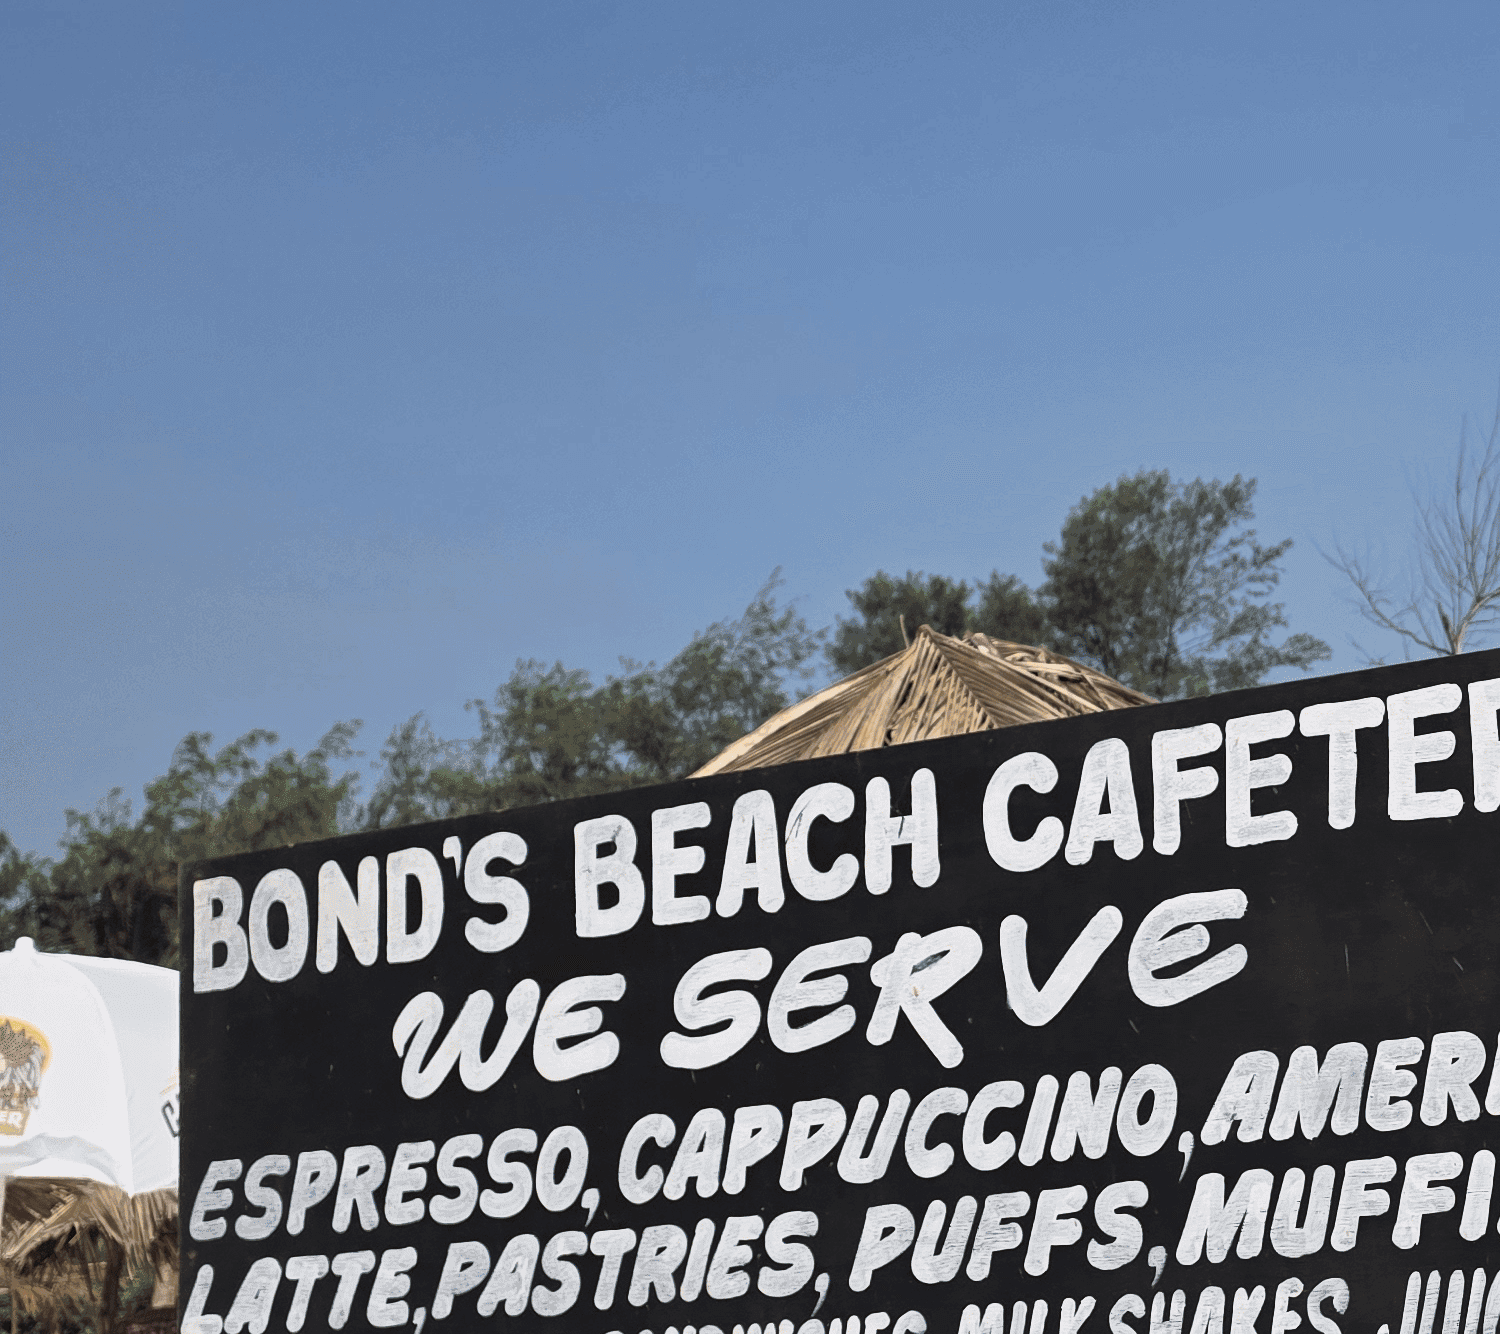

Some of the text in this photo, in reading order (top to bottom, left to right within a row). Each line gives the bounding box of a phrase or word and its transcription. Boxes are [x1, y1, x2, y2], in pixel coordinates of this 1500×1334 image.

[193, 831, 531, 994] BOND'S
[574, 767, 941, 938] BEACH
[392, 889, 1249, 1100] WE SERVE
[189, 1125, 600, 1241] ESPRESSO,
[849, 1181, 1168, 1297] PUFFS,
